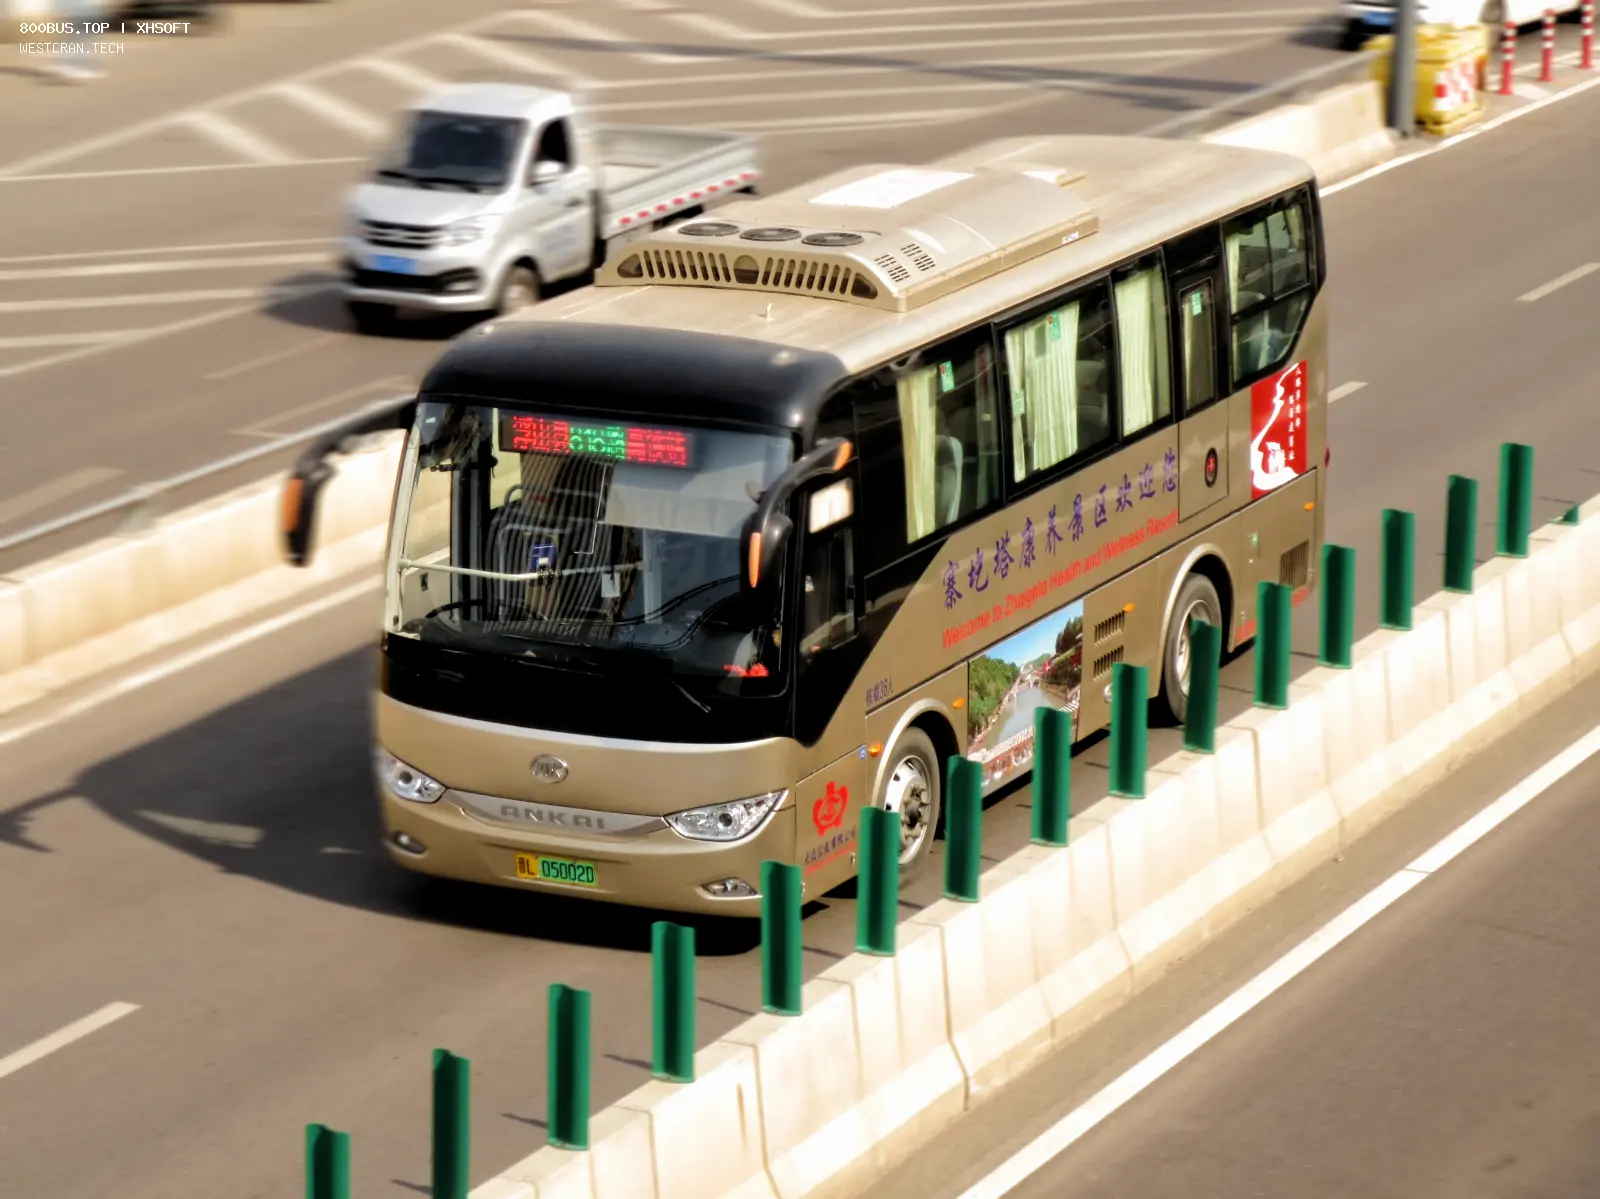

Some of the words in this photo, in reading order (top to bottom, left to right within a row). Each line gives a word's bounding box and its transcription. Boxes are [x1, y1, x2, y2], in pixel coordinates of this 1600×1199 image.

[942, 612, 991, 649] Welcome
[992, 604, 1003, 623] to
[1049, 559, 1082, 590] Health
[1083, 547, 1102, 575] and
[1103, 530, 1146, 562] Wellness
[501, 805, 606, 830] ANKAI
